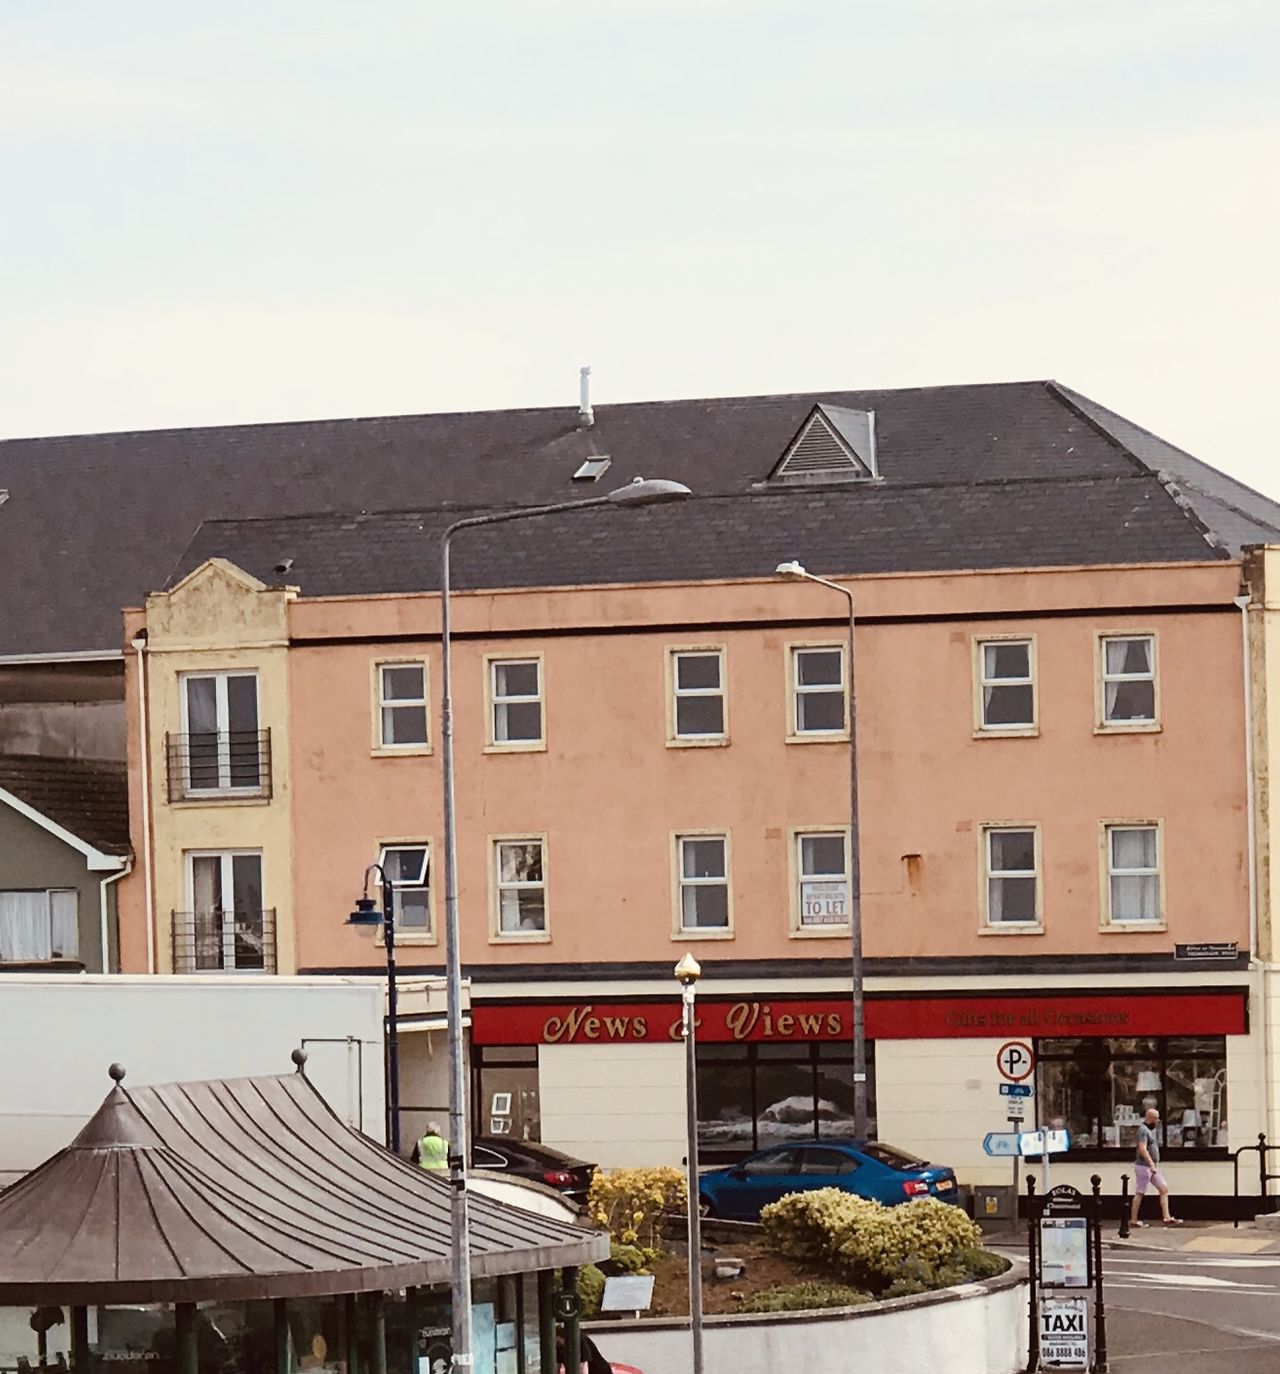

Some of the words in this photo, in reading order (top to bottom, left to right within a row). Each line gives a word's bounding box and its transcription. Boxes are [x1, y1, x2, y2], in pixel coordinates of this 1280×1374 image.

[805, 901, 822, 915] TO
[826, 900, 845, 915] LET
[543, 1005, 647, 1042] News
[726, 1002, 842, 1040] Views
[1041, 1314, 1084, 1332] TAXI
